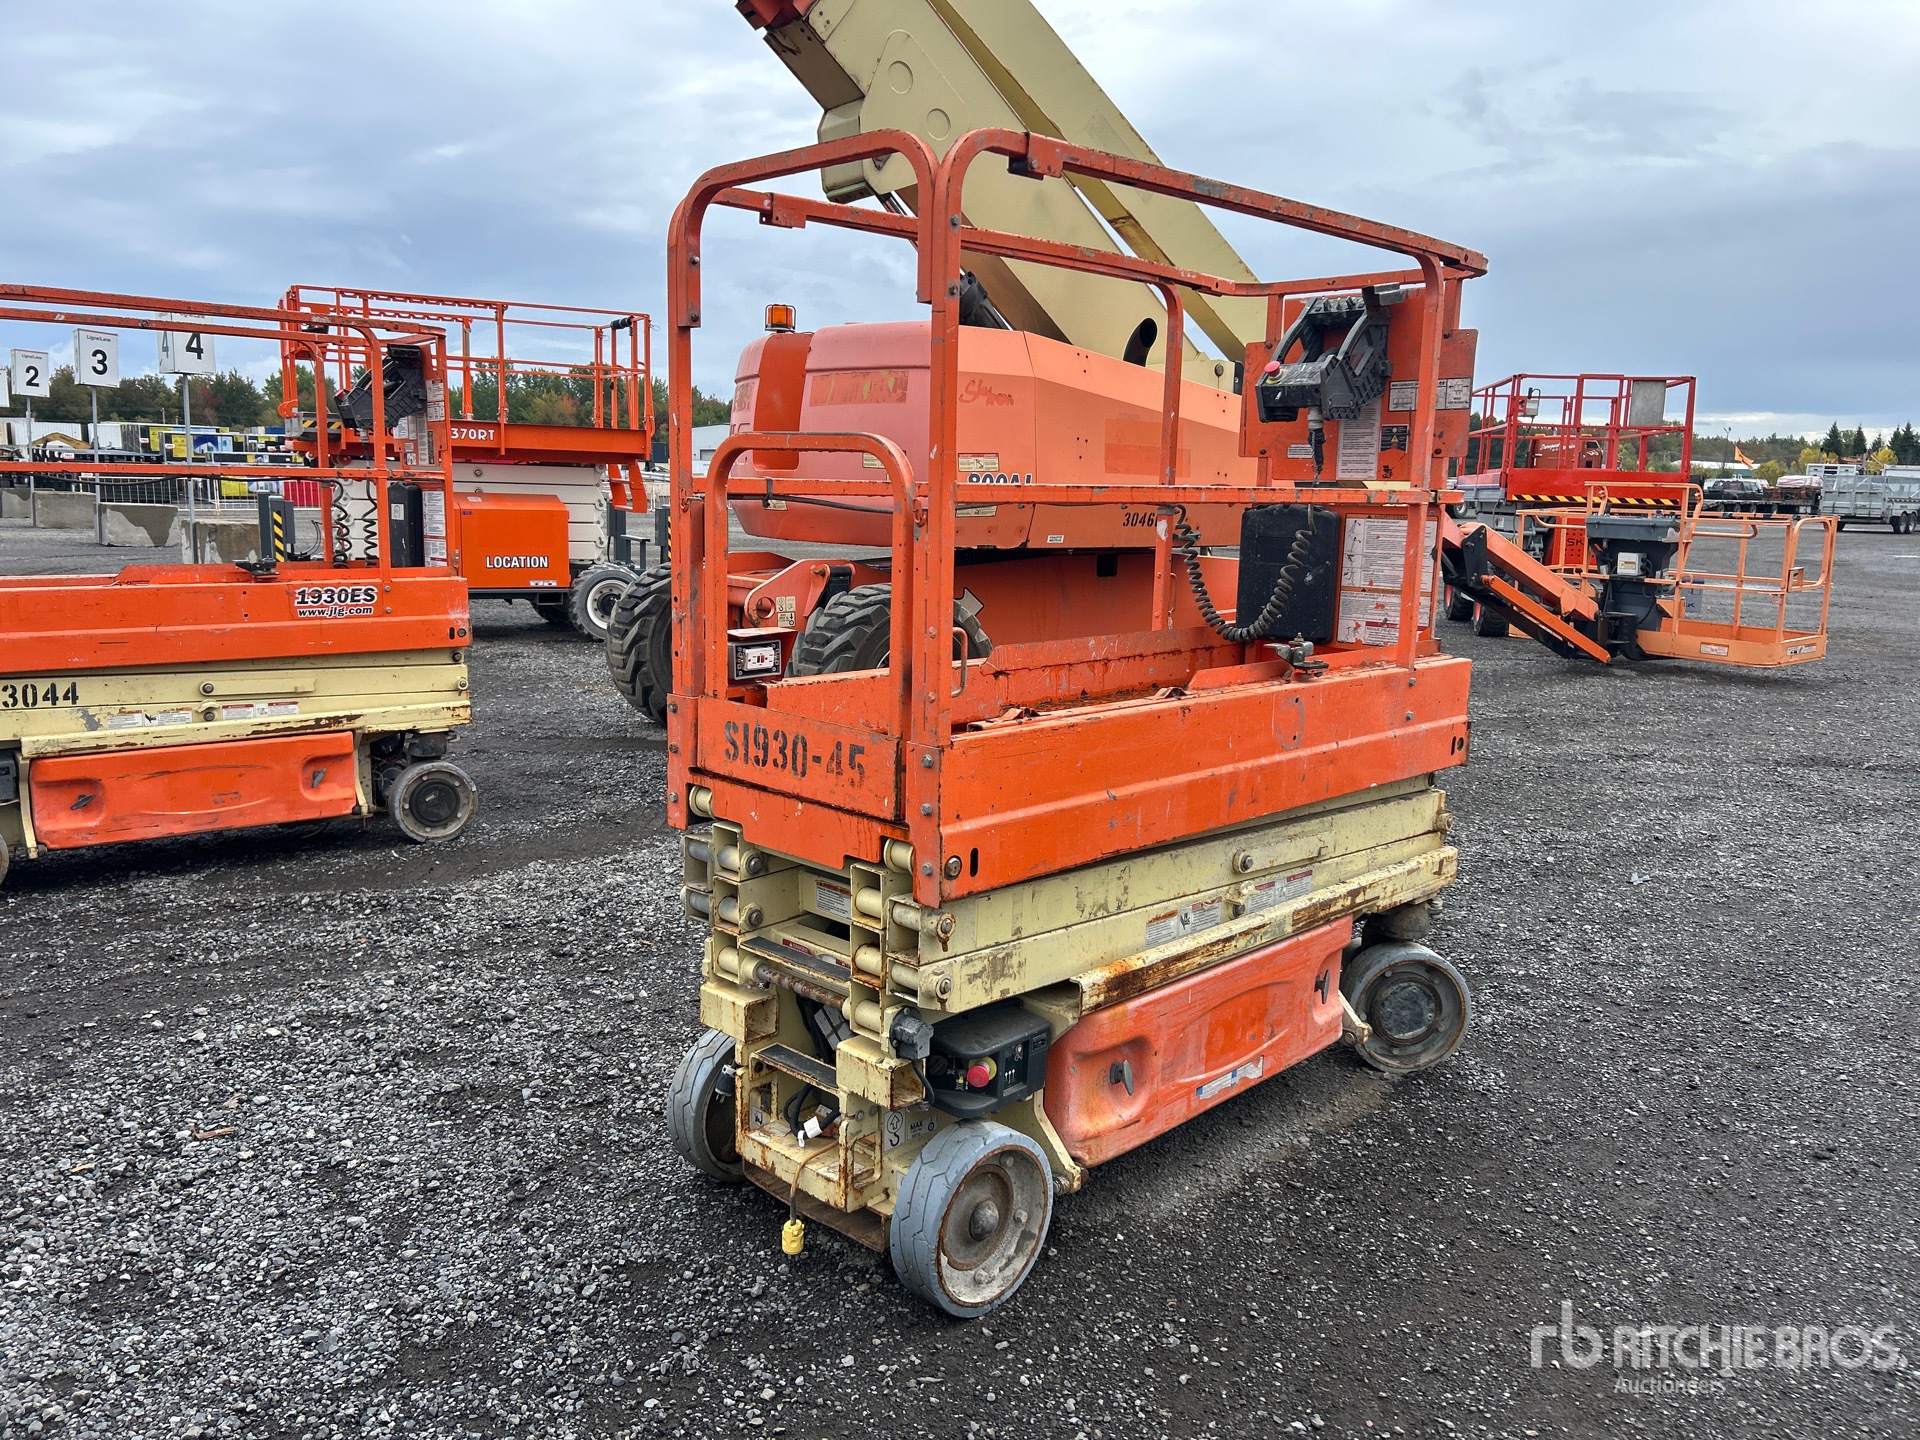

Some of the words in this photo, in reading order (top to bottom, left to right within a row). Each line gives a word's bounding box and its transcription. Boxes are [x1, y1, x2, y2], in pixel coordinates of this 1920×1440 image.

[185, 332, 204, 360] 4
[91, 349, 108, 375] 3
[25, 365, 40, 387] 2
[450, 427, 495, 441] 370RT
[1123, 512, 1158, 527] 3046
[486, 555, 549, 568] LOCATION
[296, 587, 377, 605] 1930ES
[298, 606, 373, 617] www.jlg.com
[1, 681, 79, 708] 3044
